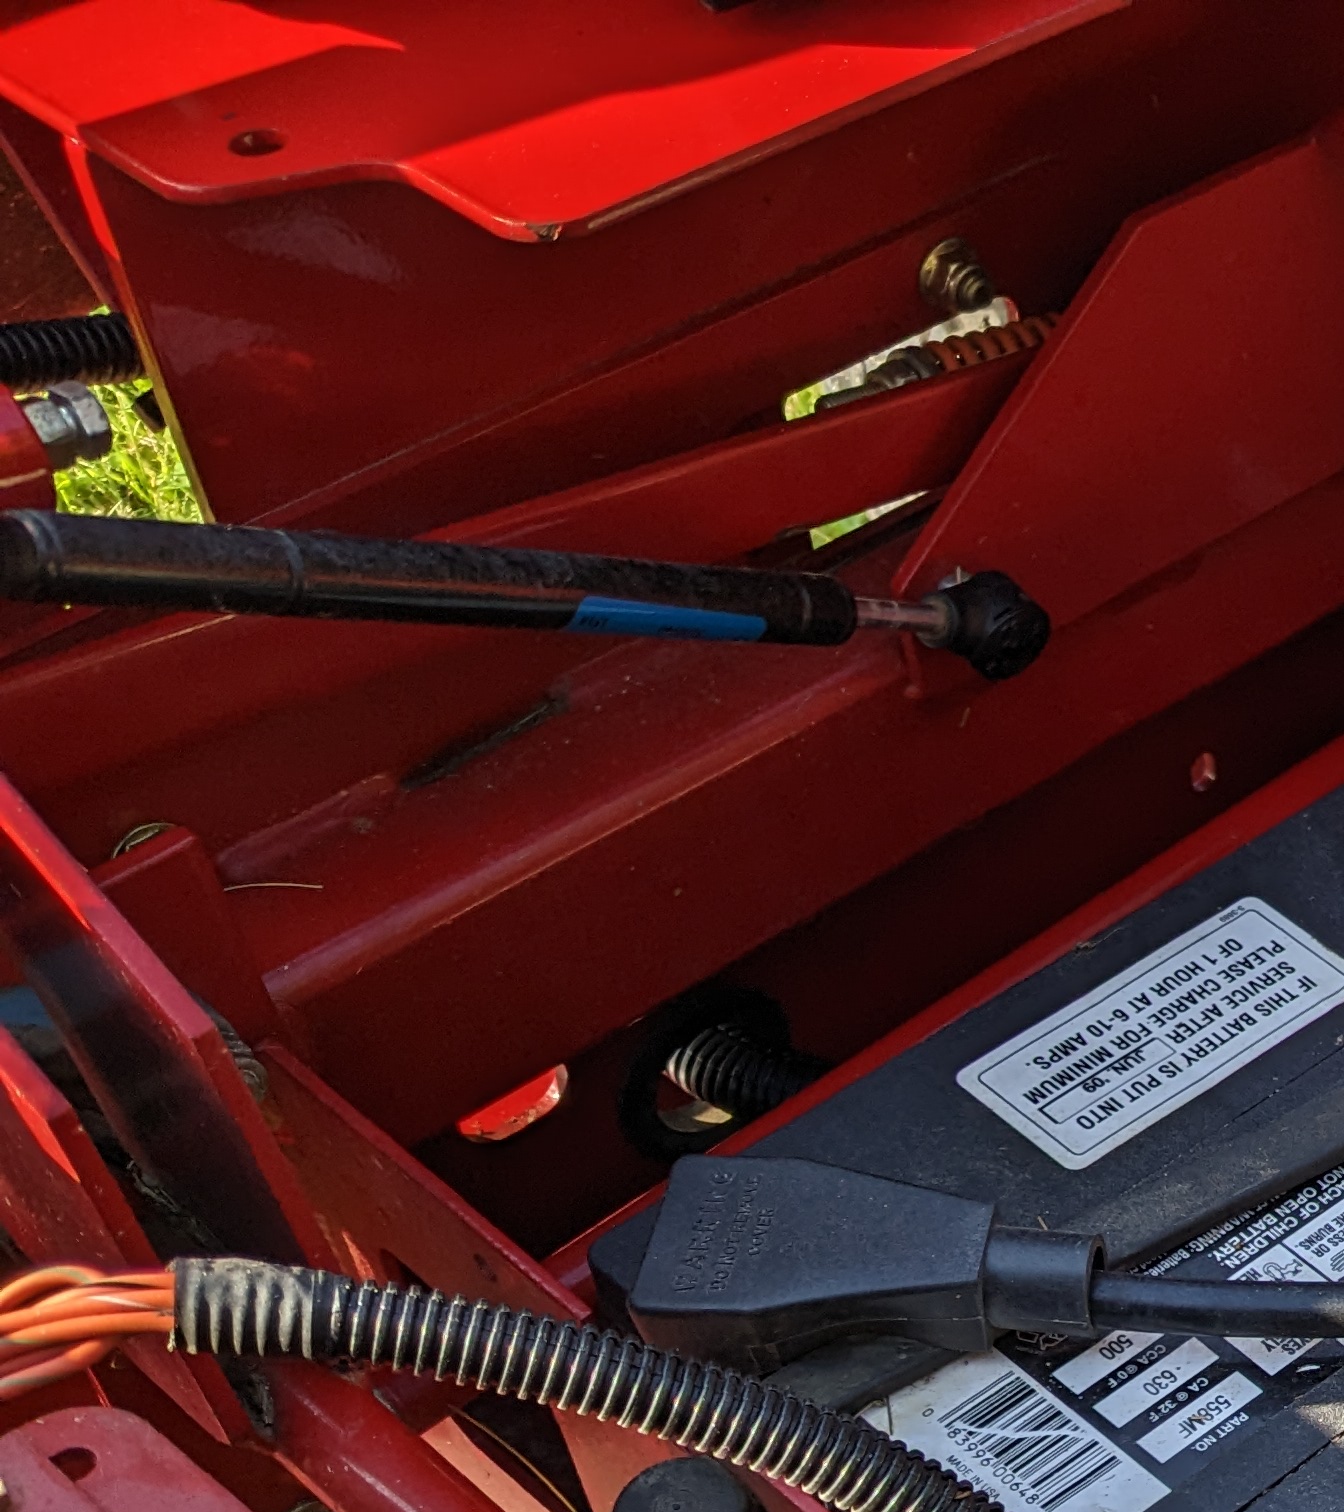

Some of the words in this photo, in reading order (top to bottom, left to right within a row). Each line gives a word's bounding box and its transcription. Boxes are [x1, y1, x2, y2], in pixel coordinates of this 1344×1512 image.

[1200, 953, 1218, 966] 1
[1215, 938, 1286, 984] PLEASE
[1217, 937, 1243, 959] OF
[1148, 960, 1206, 997] HOUR
[1219, 960, 1296, 1010] SERVICE
[1296, 974, 1318, 993] IF
[1126, 991, 1153, 1014] AT
[1146, 977, 1222, 1028] CHARGE
[1252, 987, 1300, 1017] THIS
[1084, 1007, 1130, 1038] 6-10
[1108, 1021, 1153, 1051] FOR
[1163, 1002, 1224, 1044] AFTER
[1024, 1031, 1088, 1070] AMPS.
[1179, 1011, 1258, 1067] BATTERY
[1021, 1044, 1115, 1105] MINIMUM
[1103, 1046, 1146, 1076] JUN.
[1156, 1059, 1183, 1079] IS
[1080, 1075, 1110, 1093] '09
[1120, 1072, 1162, 1103] PUT
[1075, 1095, 1125, 1130] INTO
[1273, 1186, 1317, 1218] OPEN
[1298, 1200, 1320, 1220] OF
[1206, 1212, 1278, 1262] BATTERY.
[1219, 1215, 1299, 1269] CHILDREN.
[1293, 1221, 1337, 1251] BURNS.
[1309, 1242, 1331, 1258] OR
[1142, 1247, 1191, 1277] Batterie
[1097, 1333, 1134, 1360] 500
[1135, 1343, 1167, 1365] CCA
[1280, 1329, 1314, 1355] YES
[1141, 1368, 1178, 1396] 630
[1186, 1376, 1209, 1392] CA
[1177, 1393, 1232, 1439] 558MF
[1214, 1410, 1250, 1439] PART
[920, 1406, 935, 1418] 0
[945, 1426, 994, 1467] 83996
[991, 1465, 1040, 1505] 00648
[1189, 1433, 1218, 1452] NO.
[944, 1453, 974, 1476] MADE
[968, 1473, 984, 1486] IN
